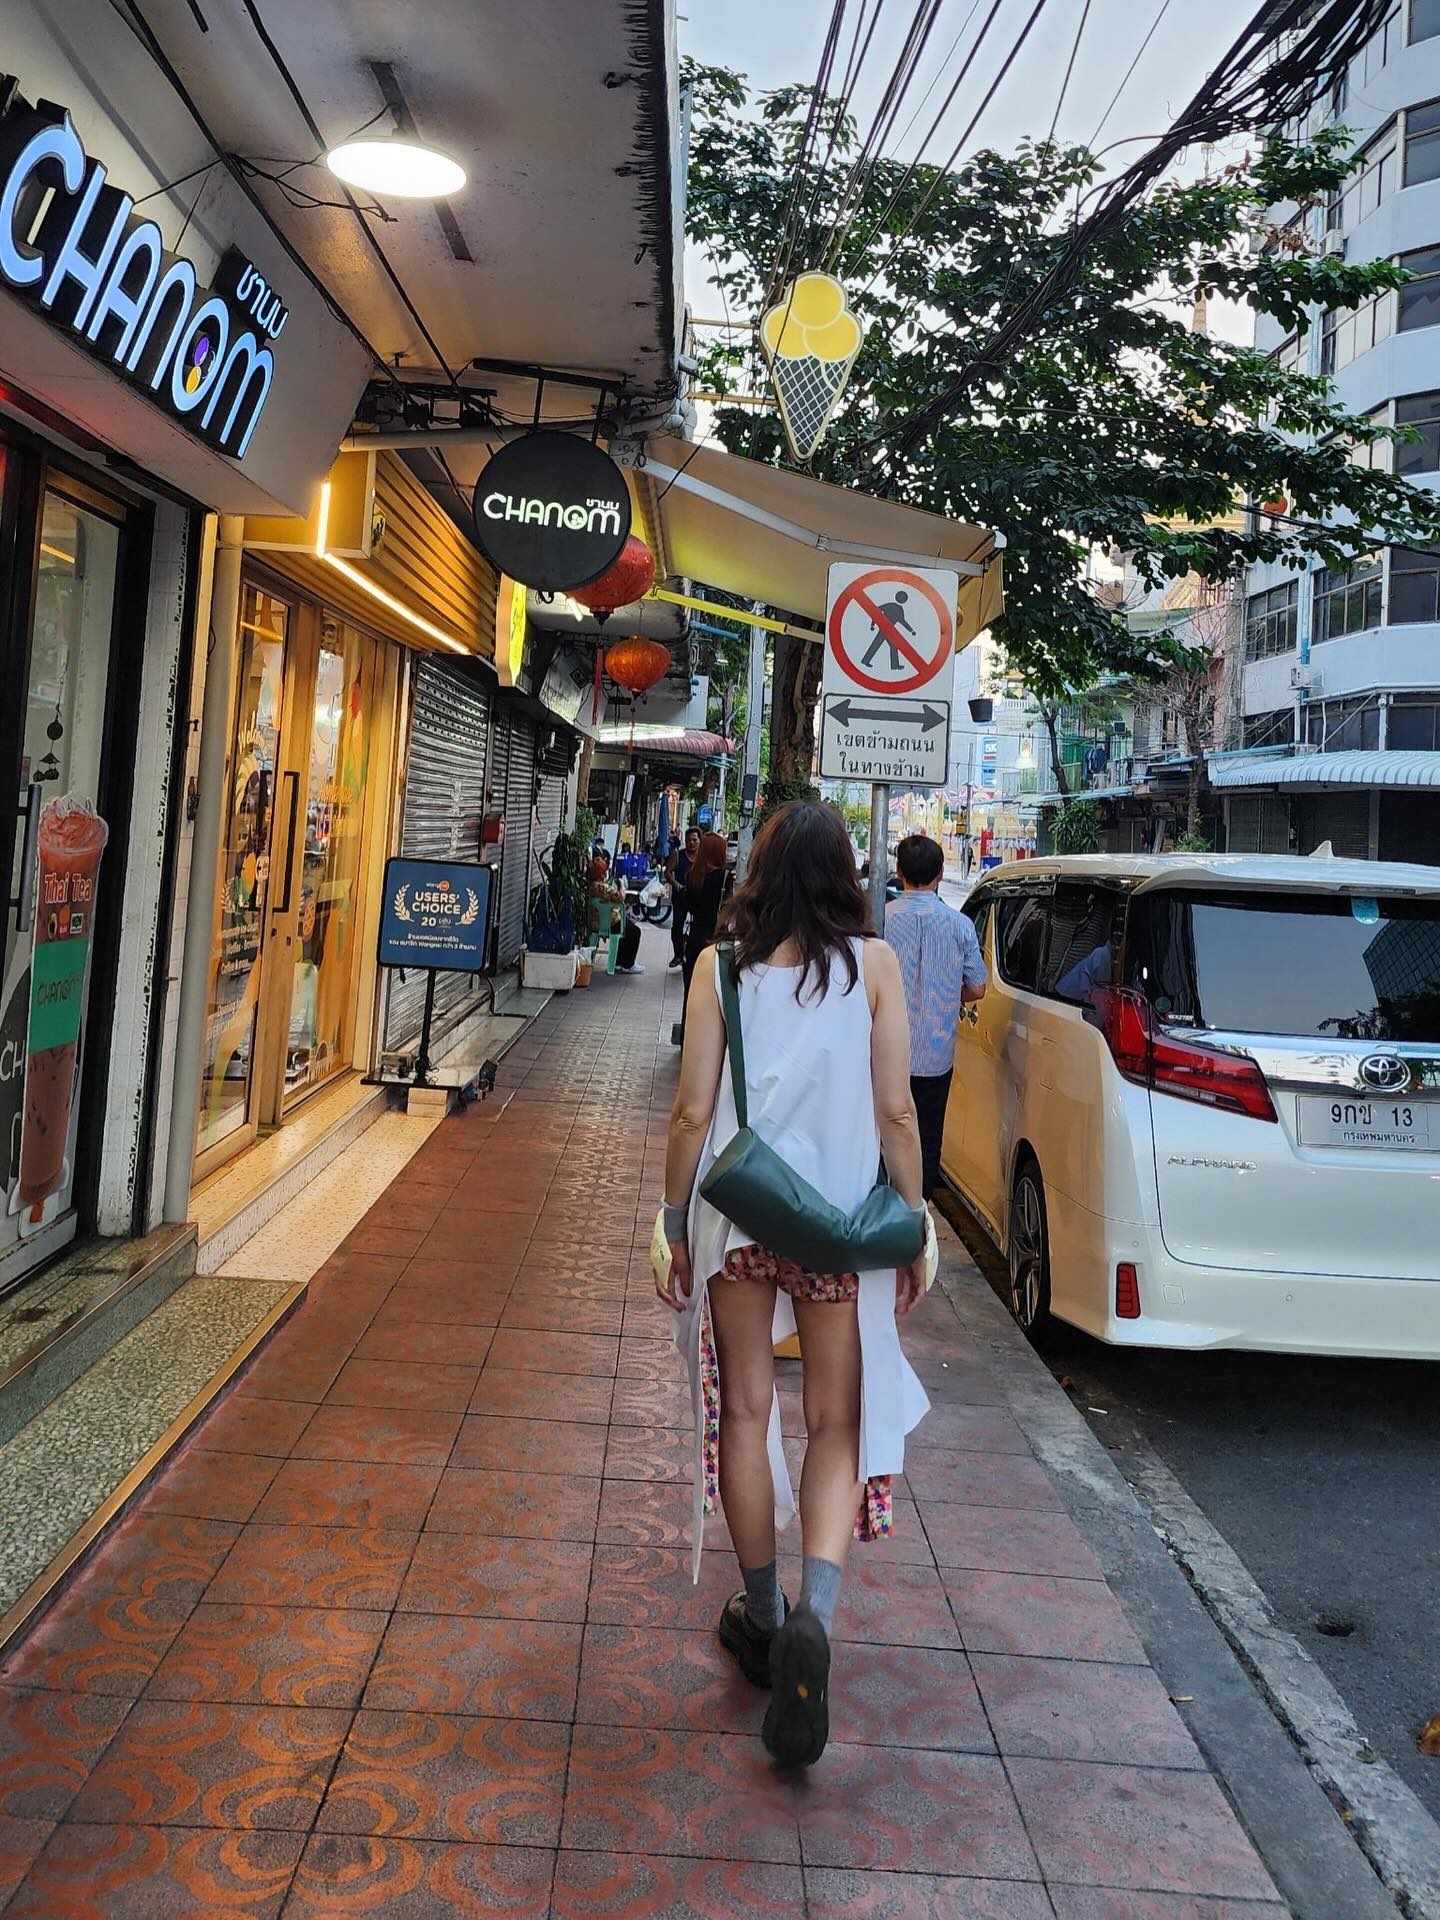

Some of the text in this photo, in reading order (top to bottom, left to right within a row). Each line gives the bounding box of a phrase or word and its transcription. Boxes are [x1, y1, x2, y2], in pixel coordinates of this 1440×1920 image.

[236, 263, 289, 339] ชานม
[483, 492, 621, 535] CHANOM
[585, 498, 620, 510] ชานม
[836, 729, 935, 753] เขตข้ามถนน
[839, 751, 925, 778] ในทางข้าม
[44, 872, 92, 904] Thai Tea
[411, 902, 461, 915] CHOICE
[1391, 1106, 1413, 1127] 13
[1343, 1131, 1415, 1144] กรุงเทพมหานคร
